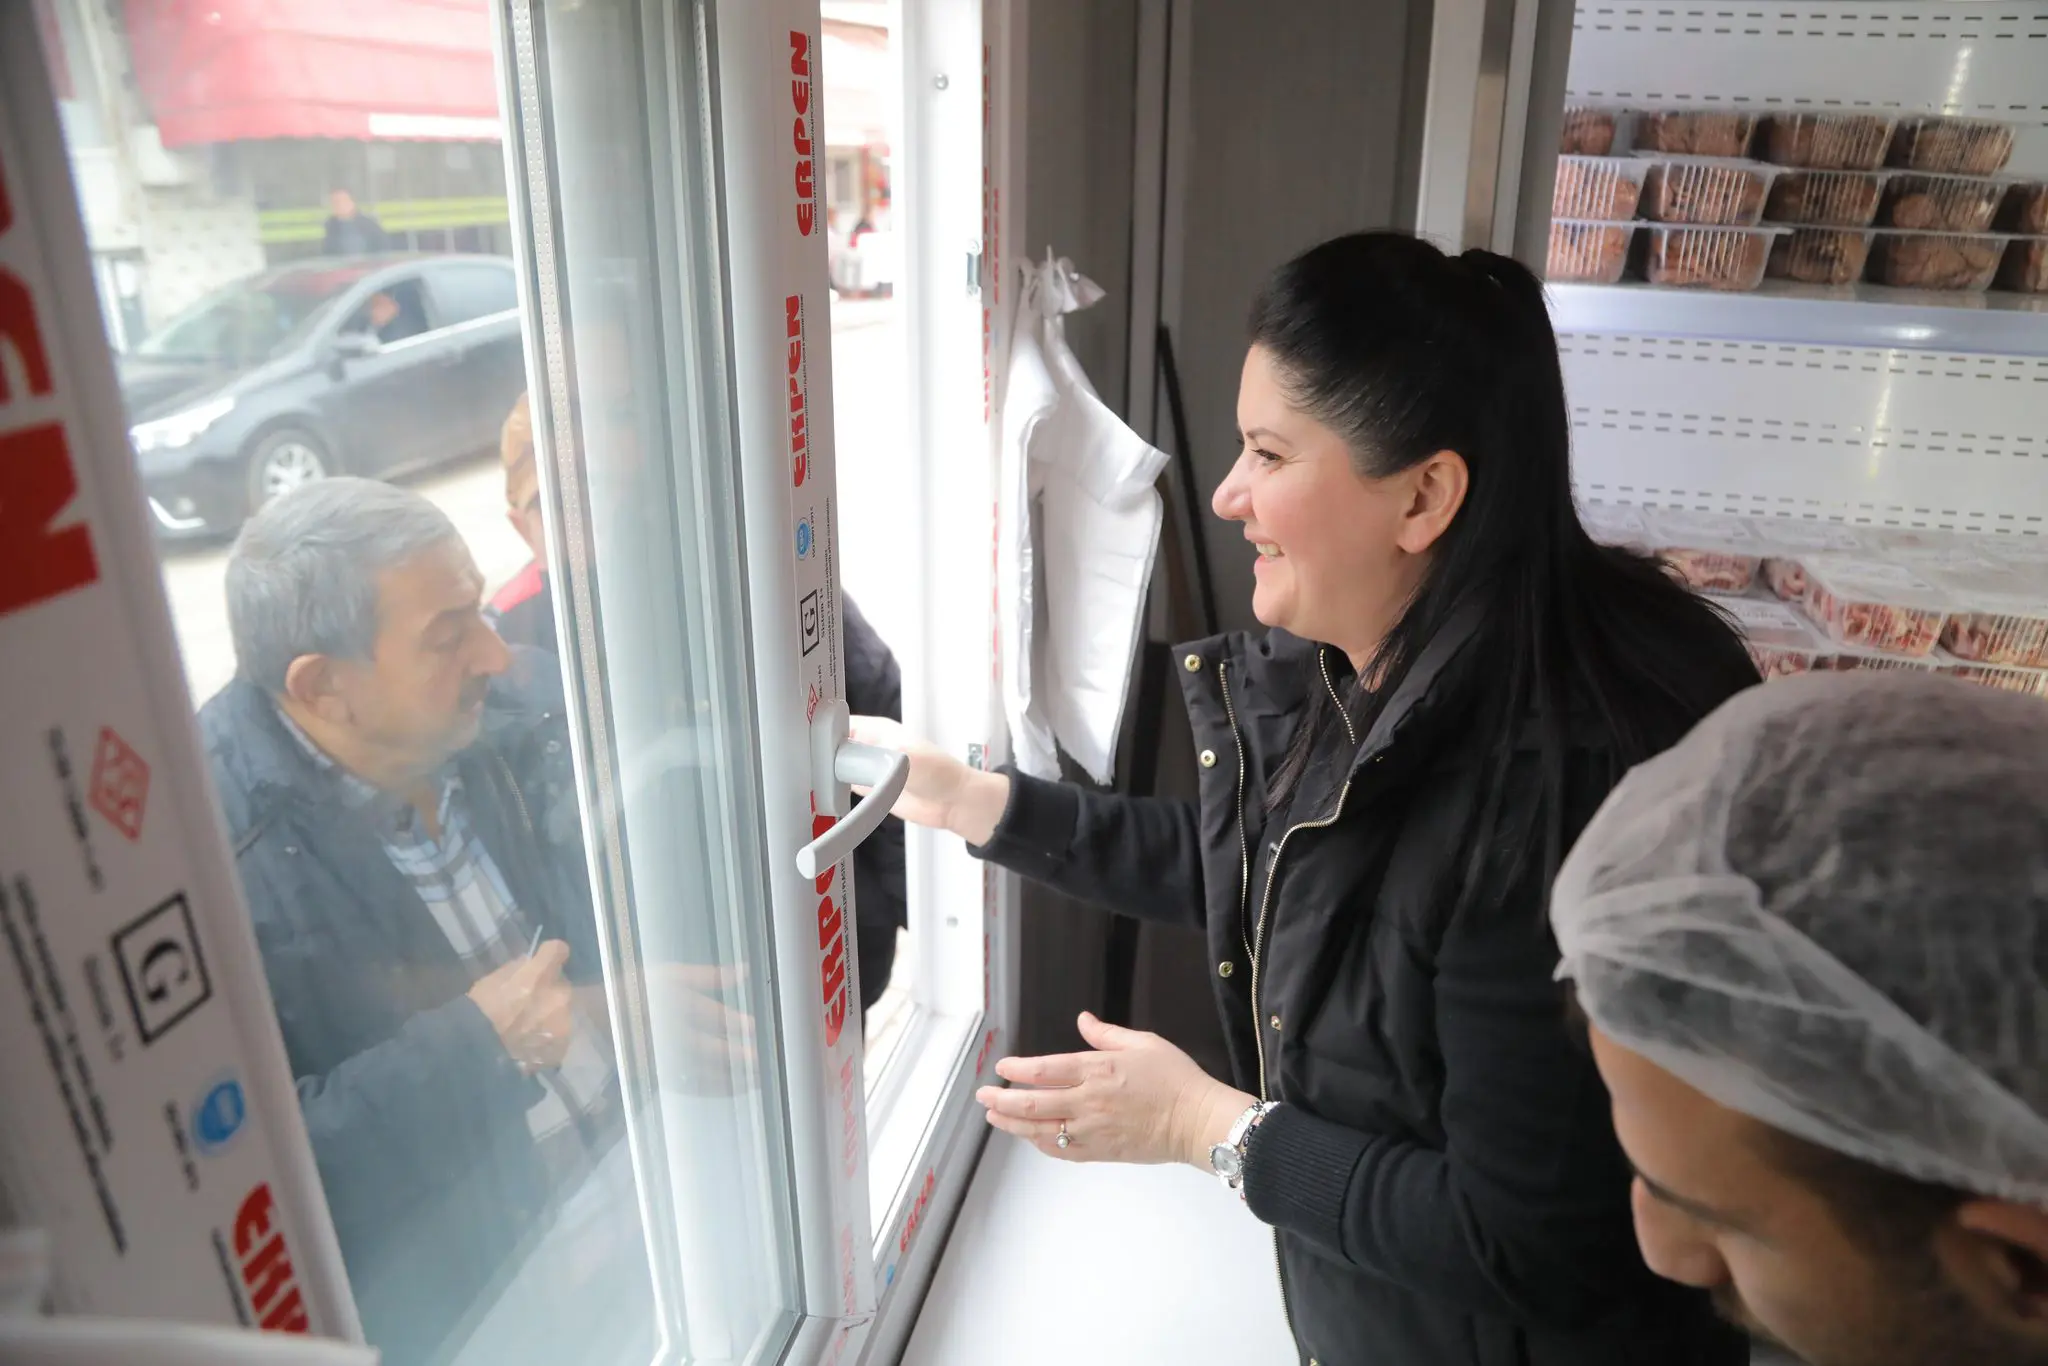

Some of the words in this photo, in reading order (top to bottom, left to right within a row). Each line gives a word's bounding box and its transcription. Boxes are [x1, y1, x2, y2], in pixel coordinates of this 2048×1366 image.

[790, 31, 813, 237] ERPEN
[786, 295, 806, 488] ERPEN
[804, 607, 816, 637] G
[139, 938, 191, 1001] G
